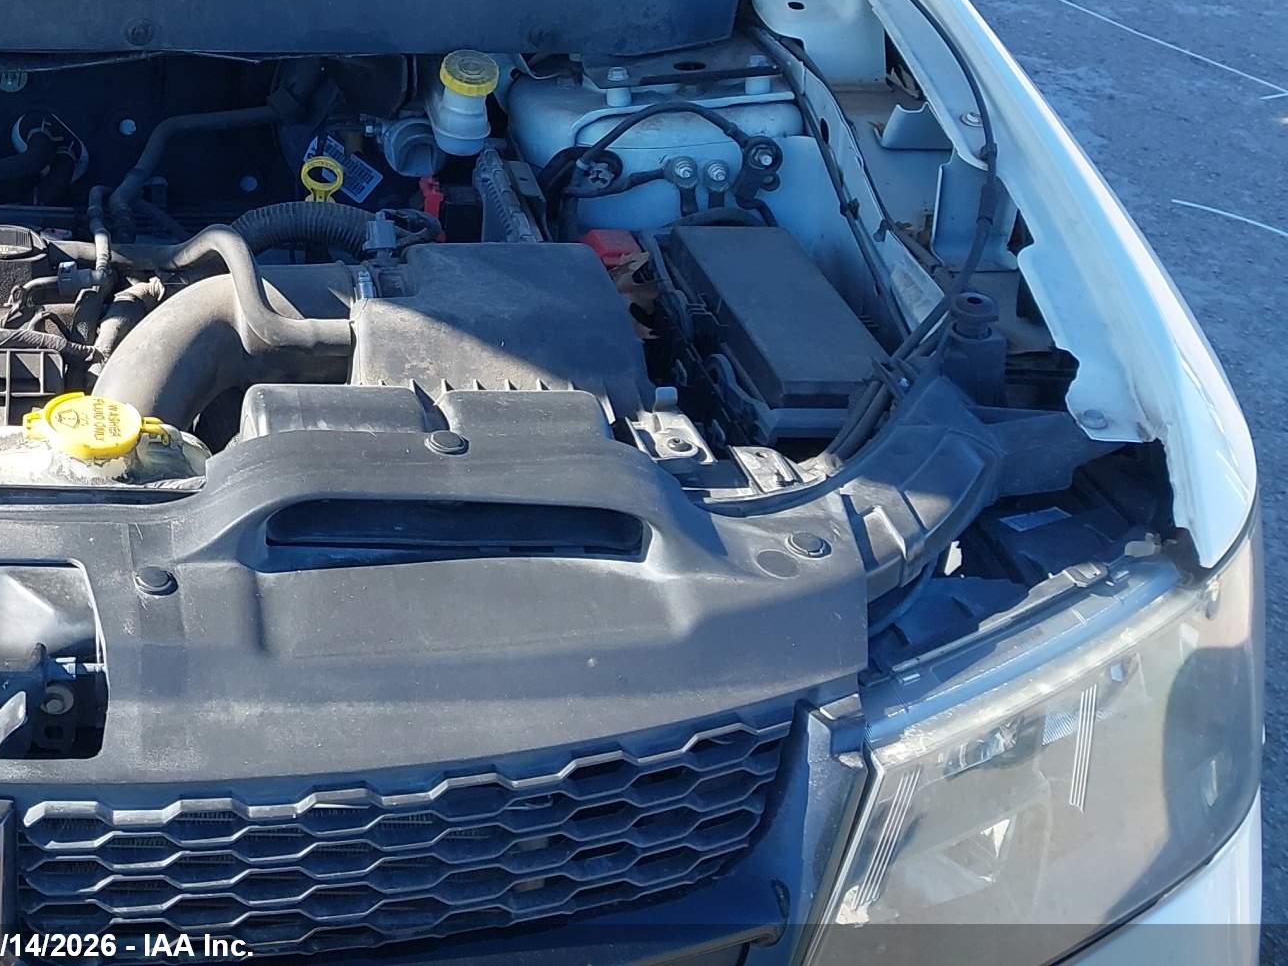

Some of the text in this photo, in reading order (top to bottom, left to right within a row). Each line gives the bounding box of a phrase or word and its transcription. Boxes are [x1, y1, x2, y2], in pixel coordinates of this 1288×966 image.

[93, 398, 105, 442] FLUID ONLY
[108, 403, 121, 437] WASHER
